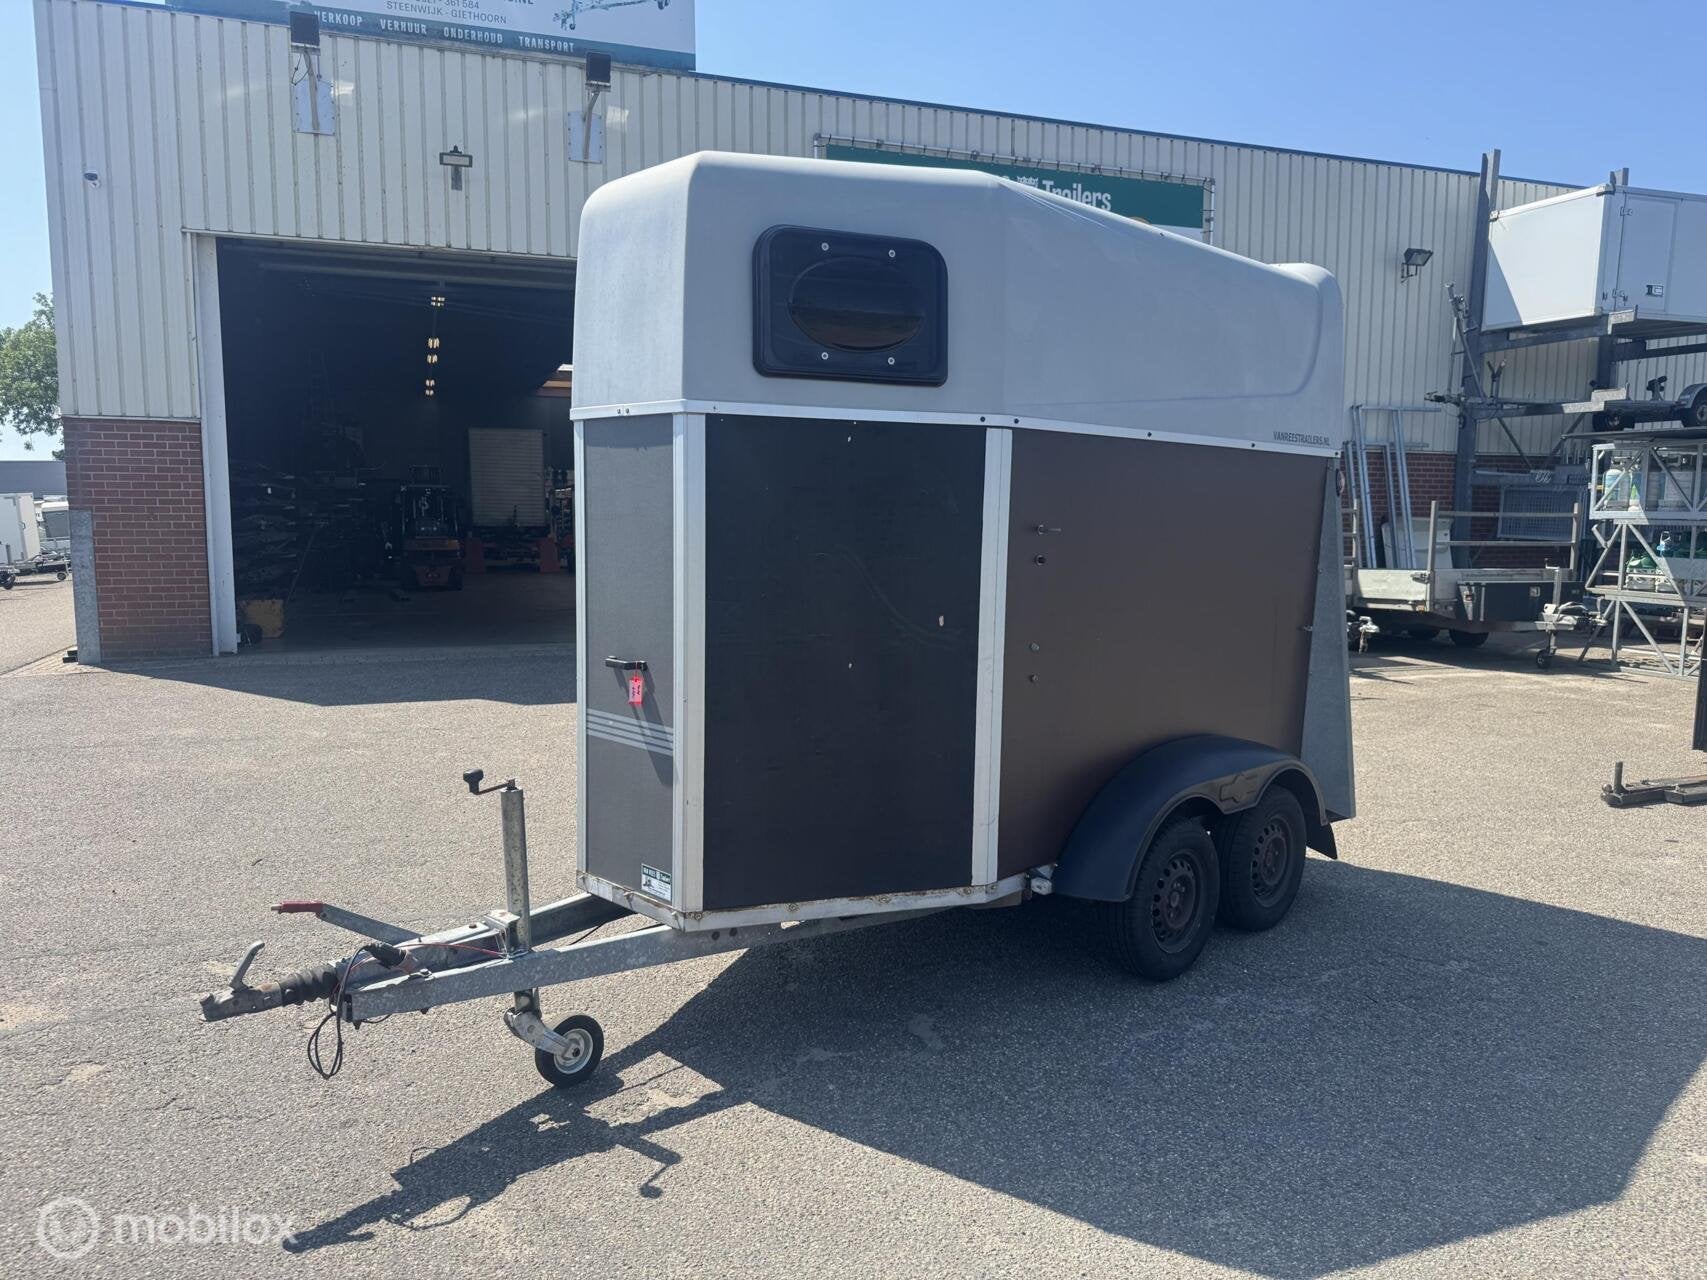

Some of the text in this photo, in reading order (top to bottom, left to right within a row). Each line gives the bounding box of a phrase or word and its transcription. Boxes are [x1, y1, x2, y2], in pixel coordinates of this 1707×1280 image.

[387, 1, 442, 16] STEENWIJK
[451, 9, 507, 24] GIETHOORN
[463, 0, 480, 9] 584
[314, 10, 575, 53] VERKOOP VERHUUR ONDERHOUD TRANSPORT
